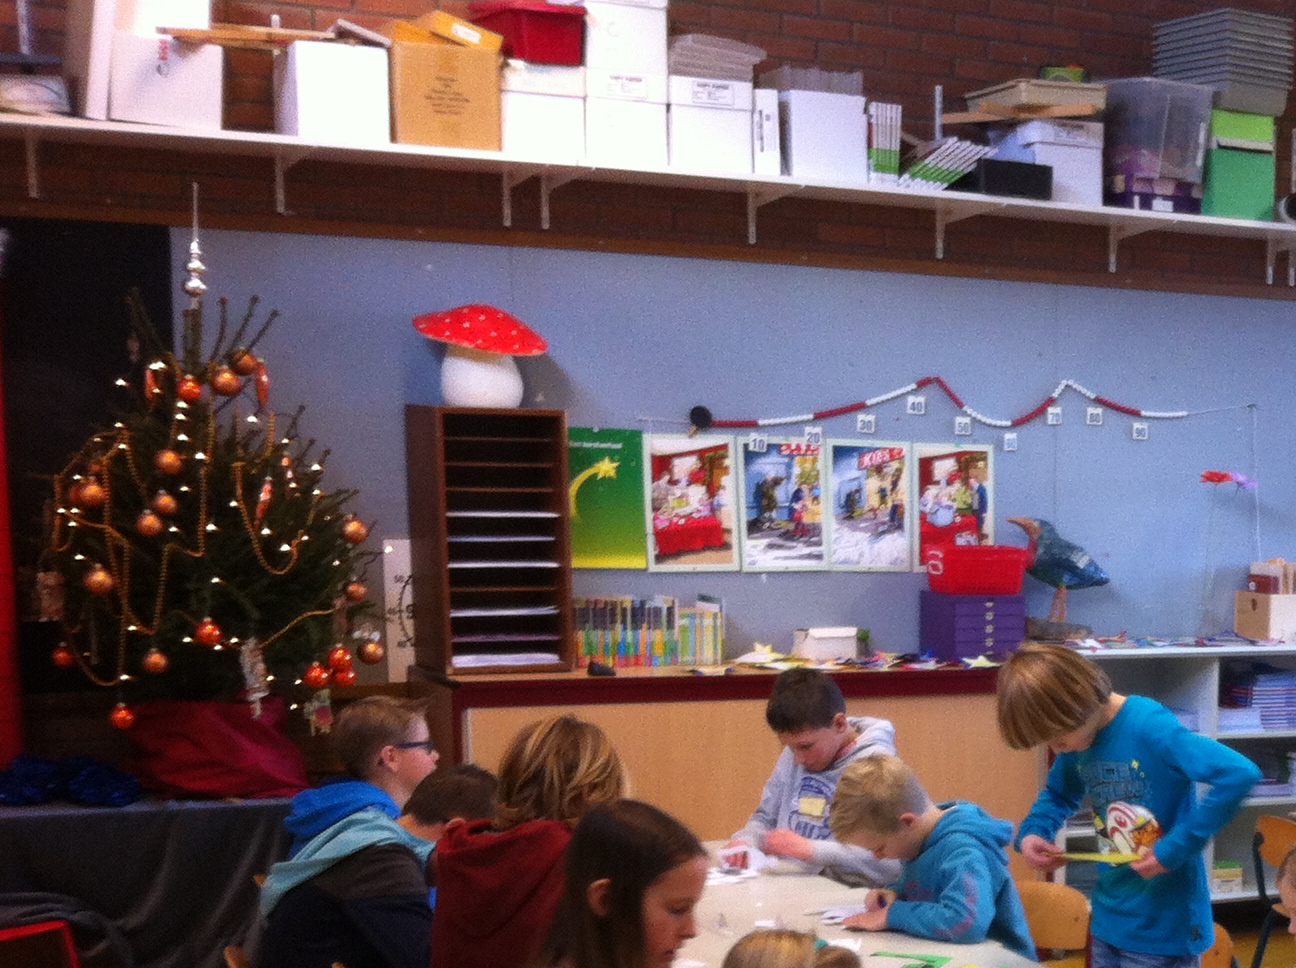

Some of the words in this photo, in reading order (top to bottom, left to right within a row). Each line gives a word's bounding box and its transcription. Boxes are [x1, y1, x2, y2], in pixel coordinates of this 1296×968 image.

[910, 401, 923, 412] 40
[859, 419, 873, 432] 30
[957, 421, 969, 433] 50
[807, 431, 820, 444] 20
[752, 438, 765, 451] 10
